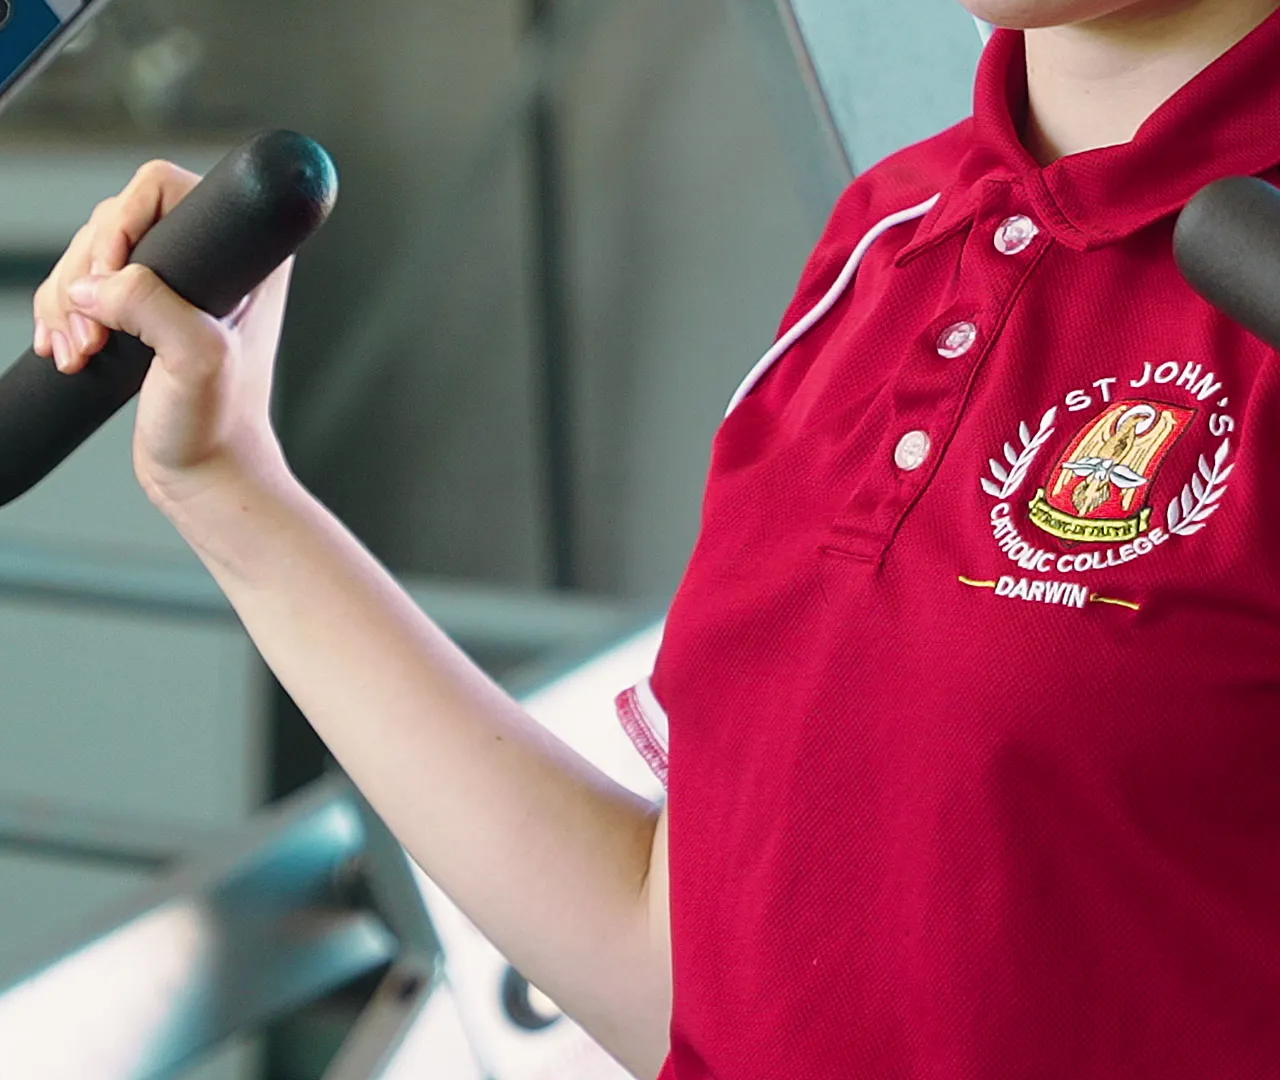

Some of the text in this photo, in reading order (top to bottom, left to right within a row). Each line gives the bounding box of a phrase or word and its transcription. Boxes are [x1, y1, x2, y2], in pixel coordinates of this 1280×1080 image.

[1065, 361, 1235, 436] ST JOHN'S
[990, 502, 1170, 572] CATHOLIC COLLEGE
[995, 576, 1089, 608] DARWIN
